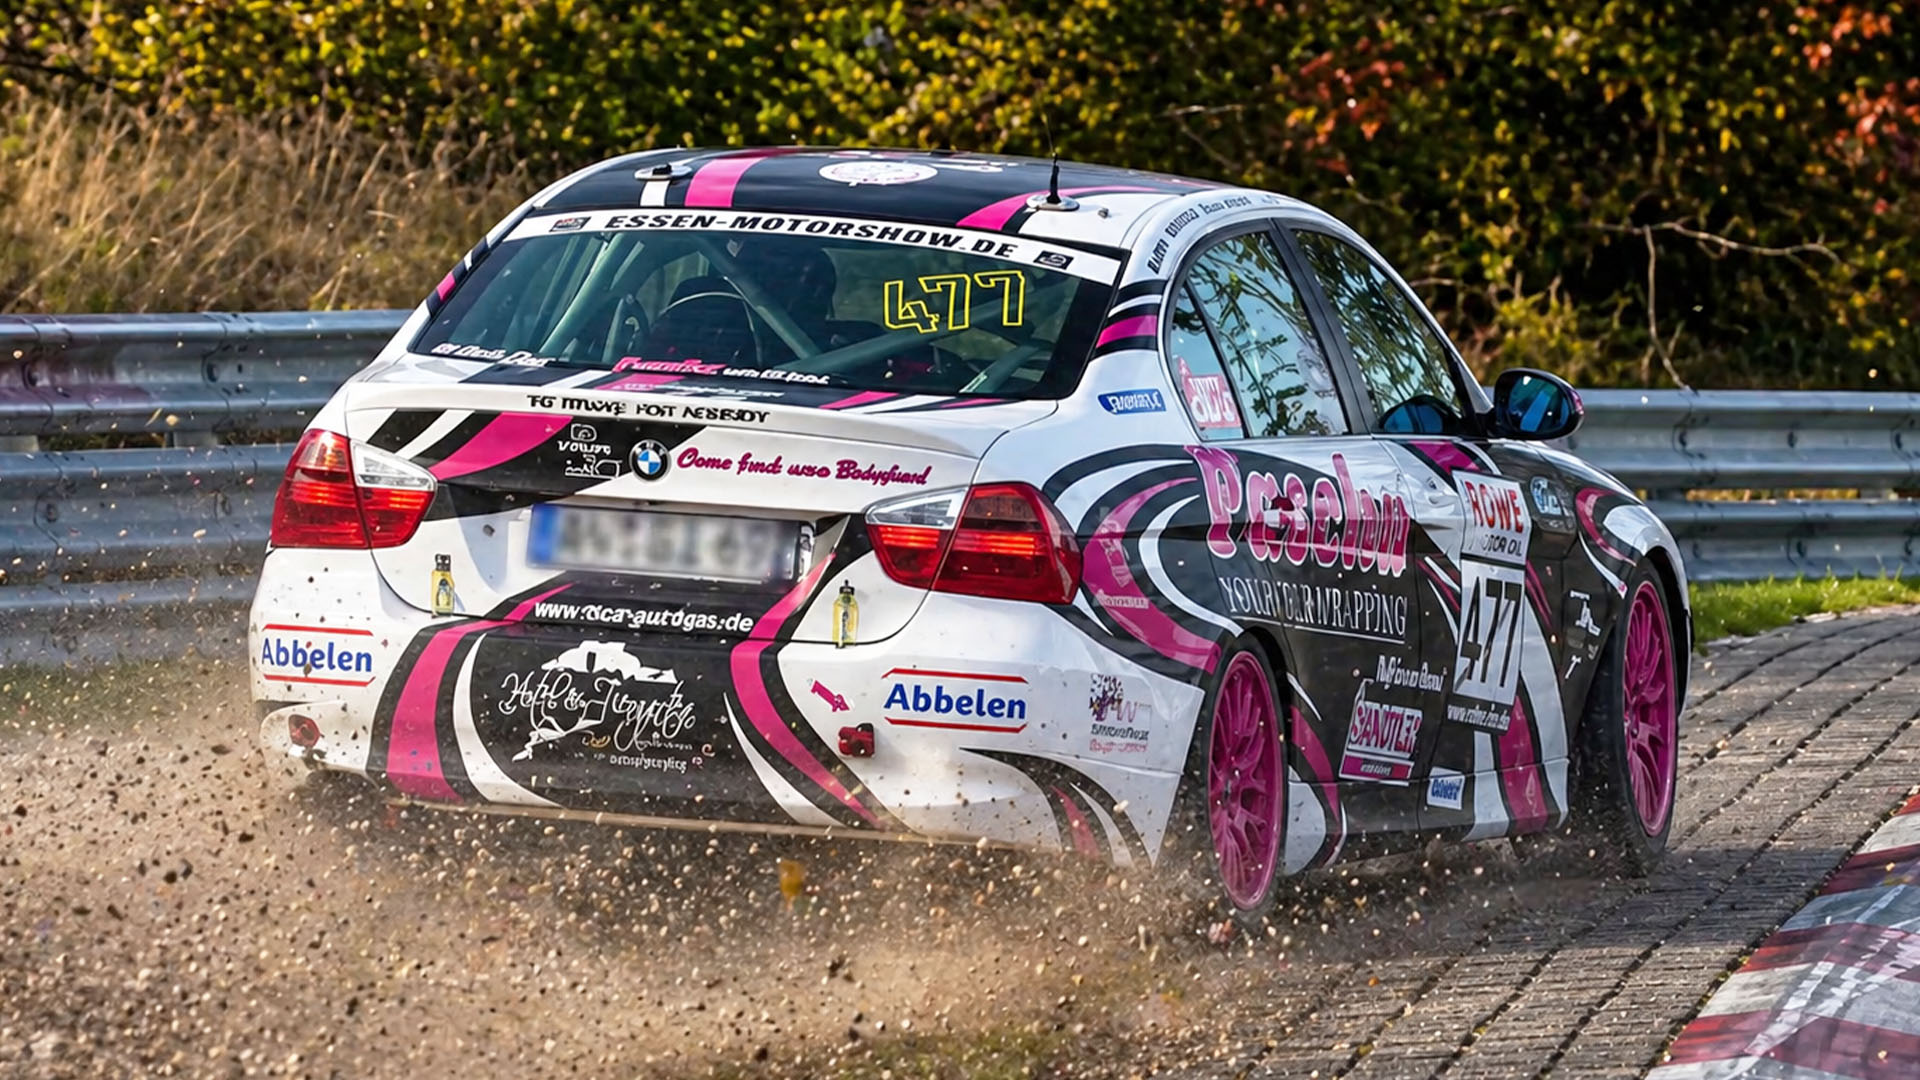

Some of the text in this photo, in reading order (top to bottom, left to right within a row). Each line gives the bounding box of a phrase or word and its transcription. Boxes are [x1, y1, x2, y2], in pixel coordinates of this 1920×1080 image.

[604, 213, 1019, 258] ESSEN-MOTORSHOW.DE
[883, 269, 1026, 334] 477
[1464, 480, 1524, 534] ROWE
[261, 637, 373, 673] Abbelen
[1459, 576, 1523, 689] 477
[883, 682, 1027, 720] Abbelen
